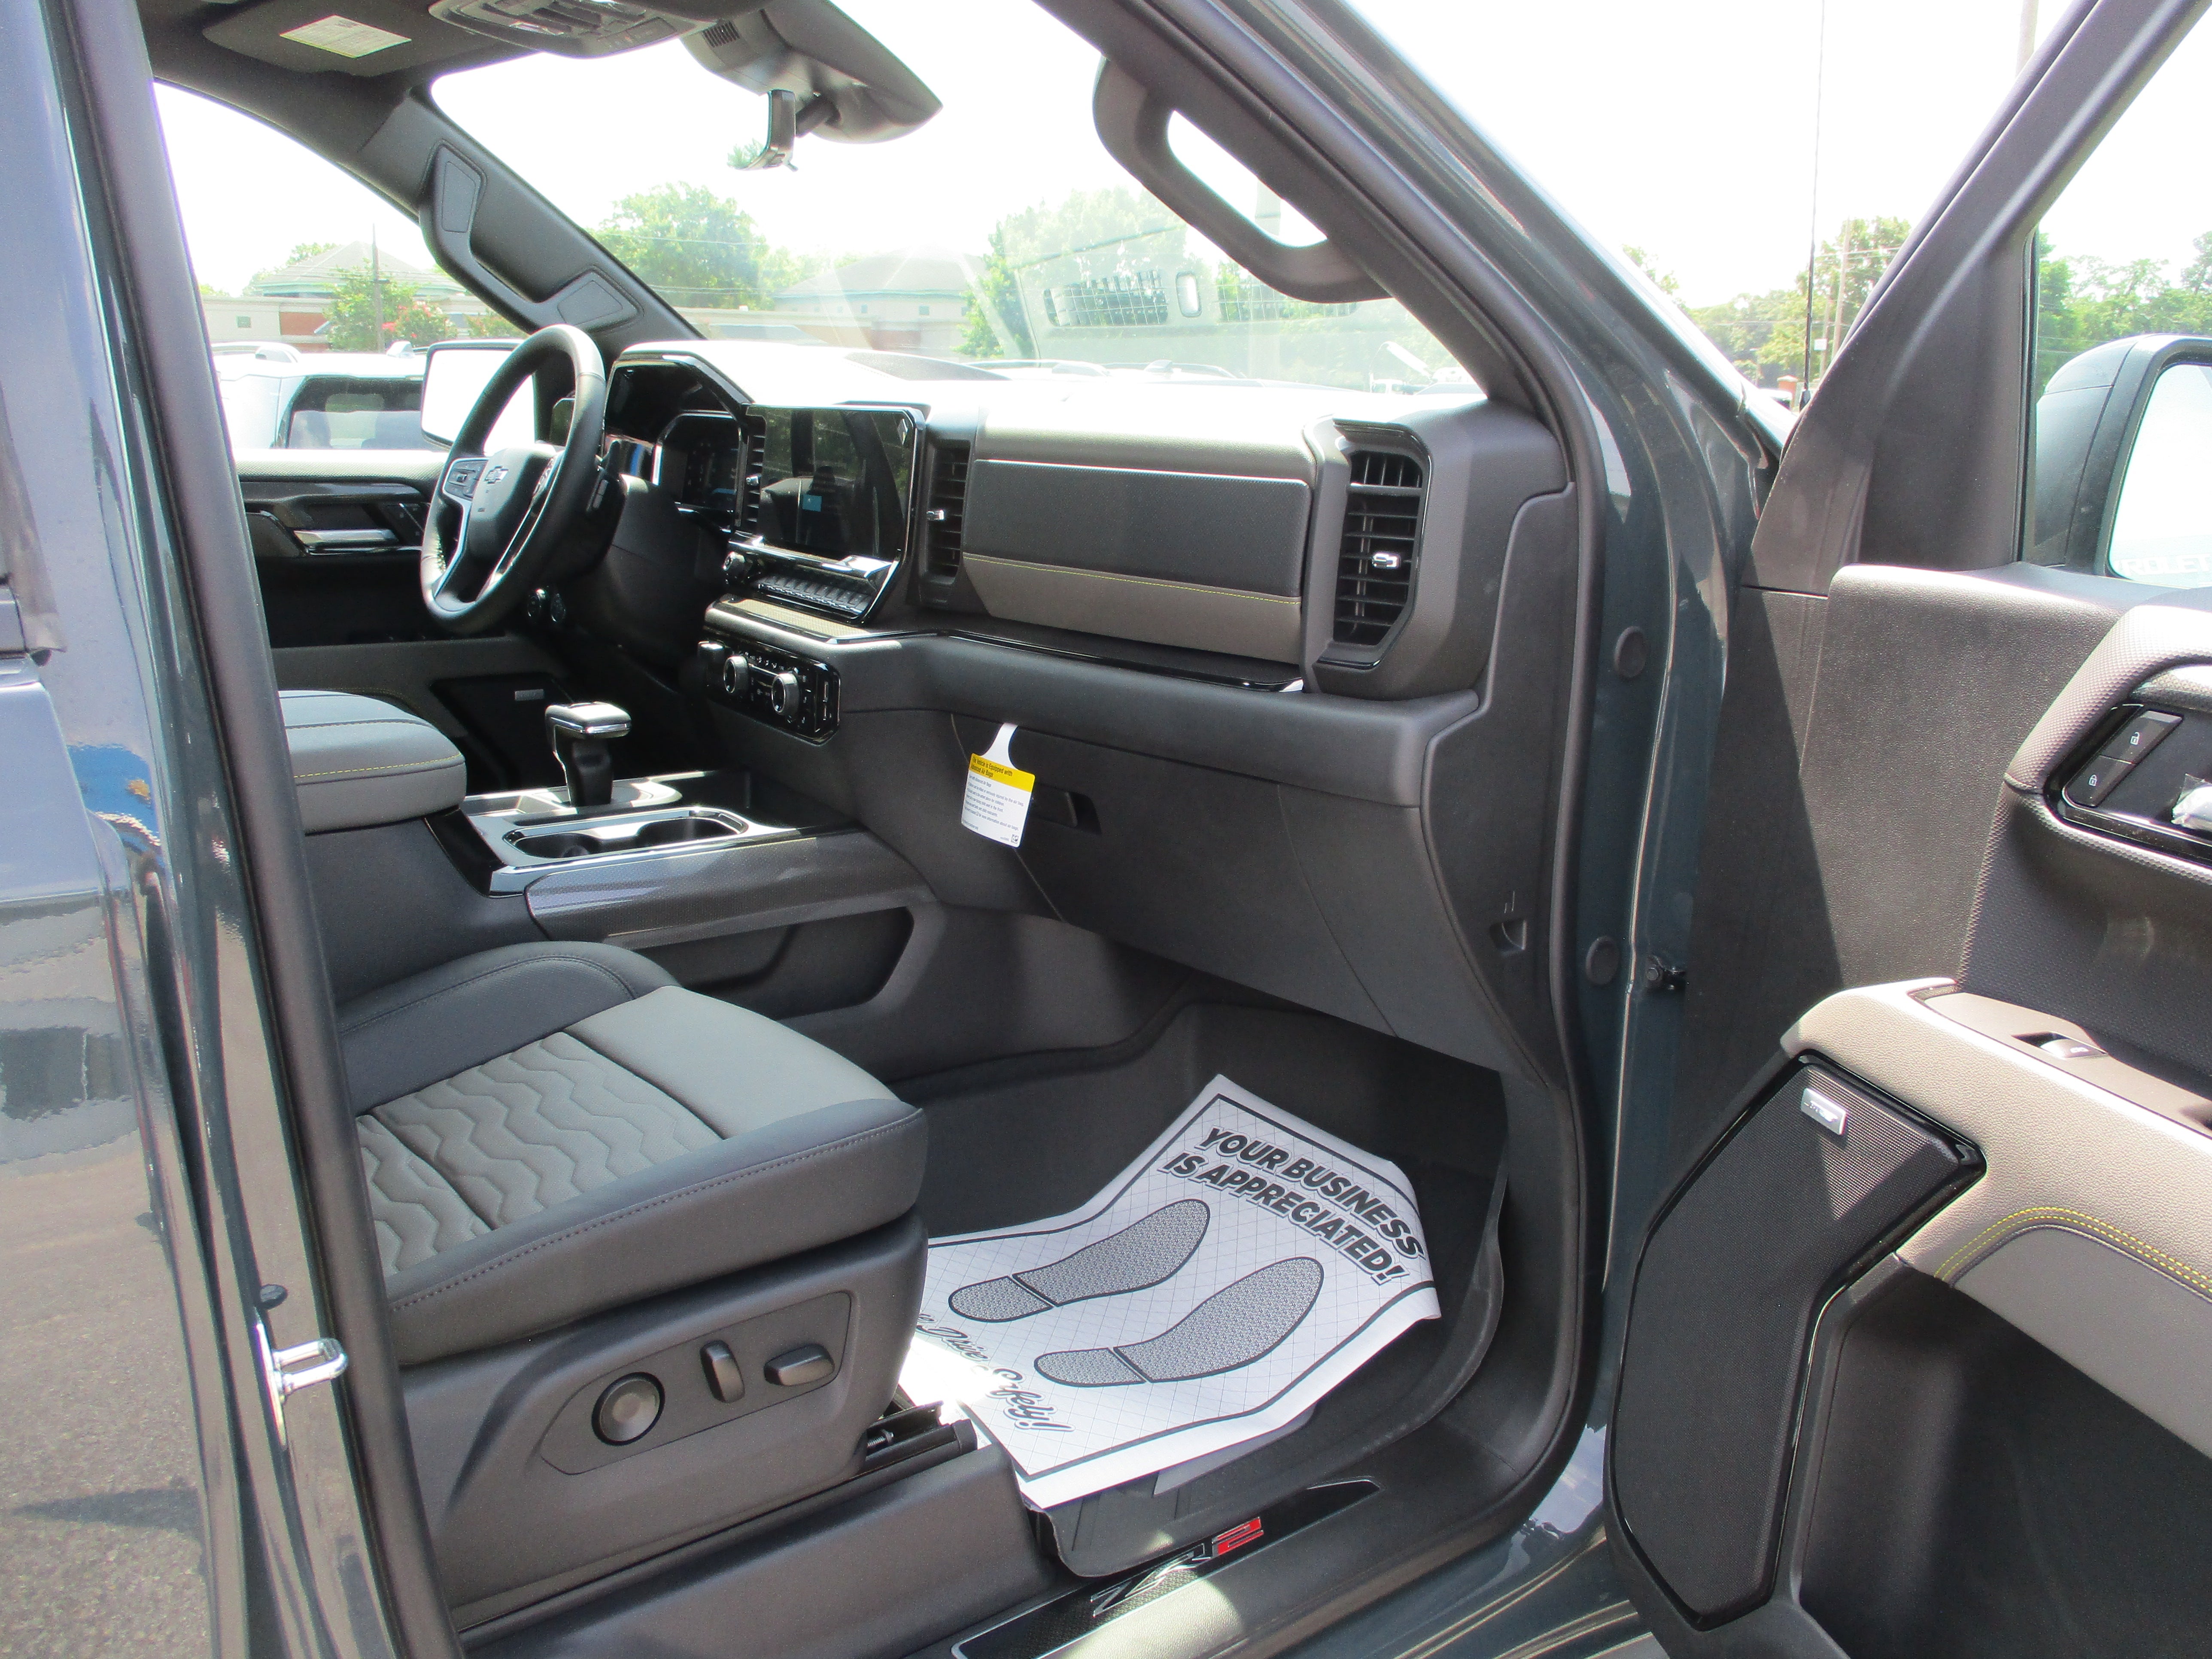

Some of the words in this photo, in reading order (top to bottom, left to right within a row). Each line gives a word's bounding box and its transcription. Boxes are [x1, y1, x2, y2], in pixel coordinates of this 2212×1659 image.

[985, 769, 994, 778] Bags
[988, 763, 1004, 775] Equipped
[1003, 768, 1013, 777] with
[1159, 1151, 1207, 1177] IS
[1192, 1163, 1407, 1284] APPRECIATED!
[1198, 1126, 1291, 1172] YOUR
[1279, 1156, 1425, 1258] BUSINESS
